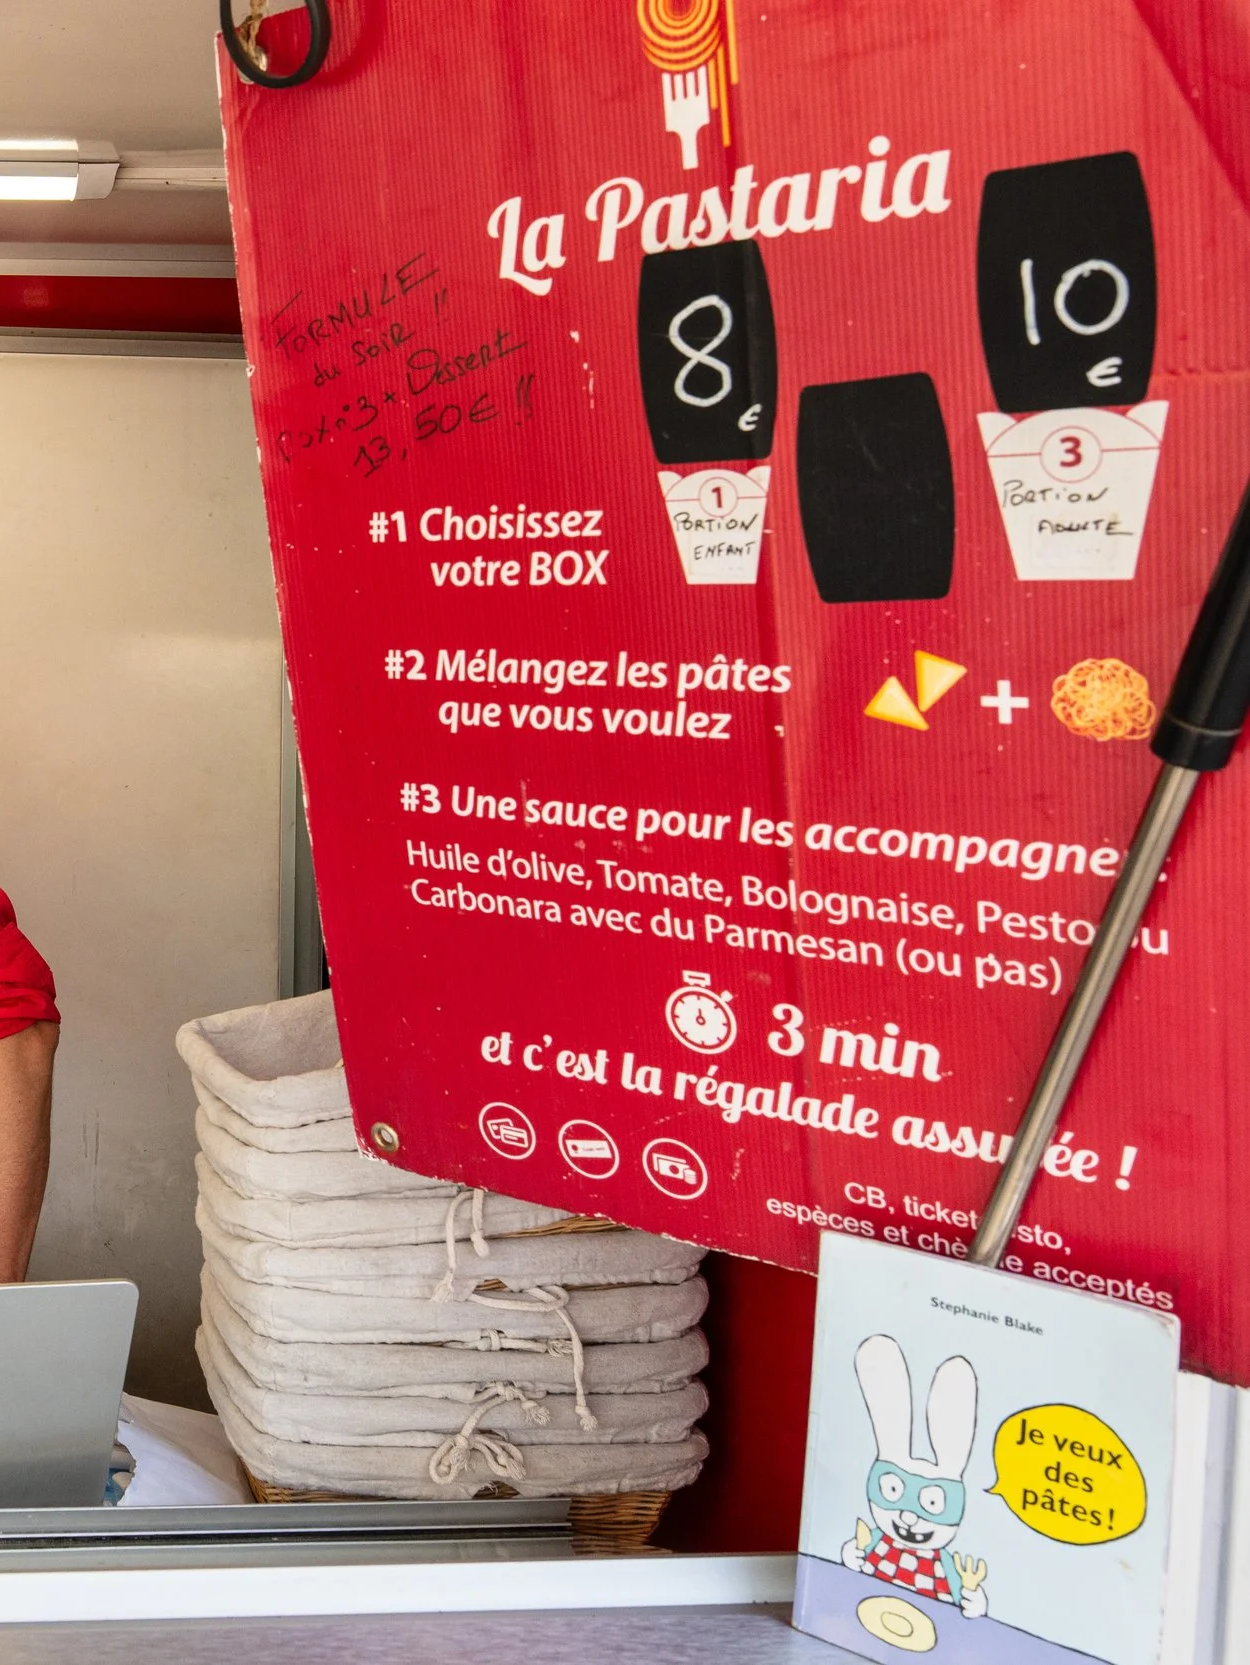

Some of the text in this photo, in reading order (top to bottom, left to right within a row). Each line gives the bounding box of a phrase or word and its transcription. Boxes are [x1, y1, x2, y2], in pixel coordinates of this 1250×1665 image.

[487, 136, 950, 296] La Pastaria
[271, 253, 439, 358] FORMULE
[1020, 259, 1129, 386] 10 €
[314, 364, 340, 388] du
[669, 295, 762, 430] 8 €
[1060, 436, 1082, 467] 3
[712, 487, 722, 508] 1
[368, 504, 603, 543] #1 Choisissez
[431, 549, 610, 587] votre BOX
[694, 541, 755, 560] ENFANT
[384, 648, 792, 698] #2 Mélangez les pâtes
[438, 701, 732, 741] que vous voulez
[400, 782, 441, 814] #3
[451, 785, 517, 821] Une
[524, 798, 628, 831] sauce
[636, 807, 730, 842] pour
[739, 807, 795, 848] les
[804, 822, 1128, 881] accompagne
[406, 839, 480, 873] Huile
[487, 848, 592, 891] d'olive,
[596, 859, 732, 907] Tomate,
[741, 875, 964, 935] Bolognaise,
[976, 900, 1095, 946] Pesto
[411, 878, 1062, 995] Carbonara avec du Parmesan (ou pas)
[768, 1002, 942, 1083] 3 min
[481, 1031, 1138, 1191] et c'est la régalade assuée !
[844, 1182, 895, 1214] CB,
[766, 1197, 1174, 1311] espèces et chèe acceptés
[930, 1296, 1045, 1337] Stephanie Blake
[1016, 1418, 1123, 1471] Je veux
[1044, 1461, 1094, 1493] des
